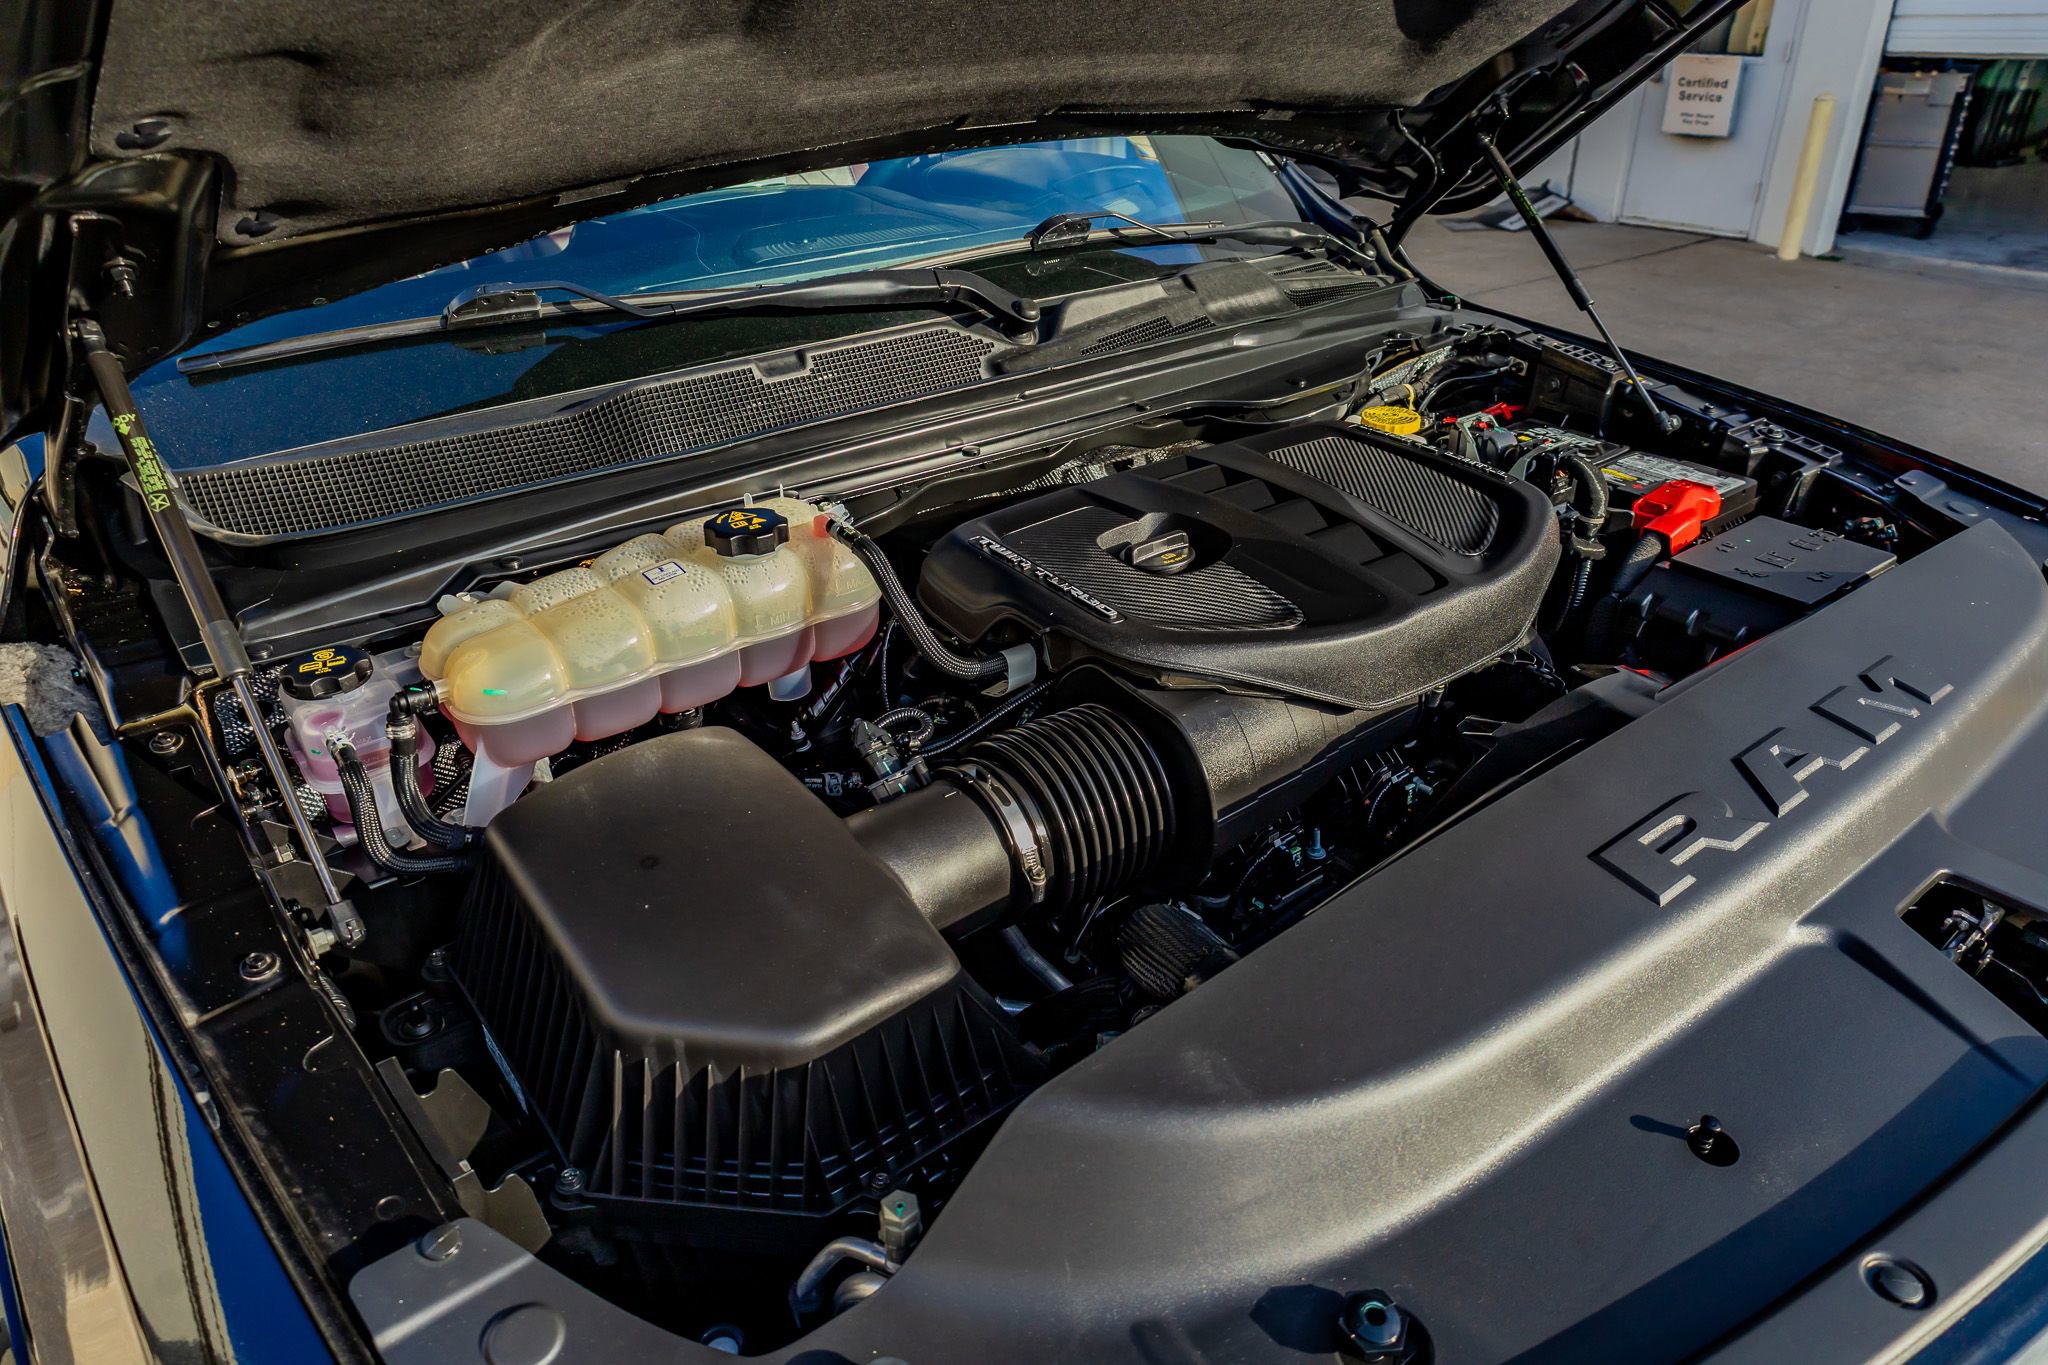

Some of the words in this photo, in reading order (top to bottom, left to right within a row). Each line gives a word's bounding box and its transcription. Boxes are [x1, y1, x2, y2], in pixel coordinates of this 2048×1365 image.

[1678, 77, 1728, 89] Certified
[1679, 90, 1722, 103] Service
[979, 536, 1032, 570] TWIN
[1035, 566, 1118, 618] TURBO
[1587, 655, 1954, 907] RAM
